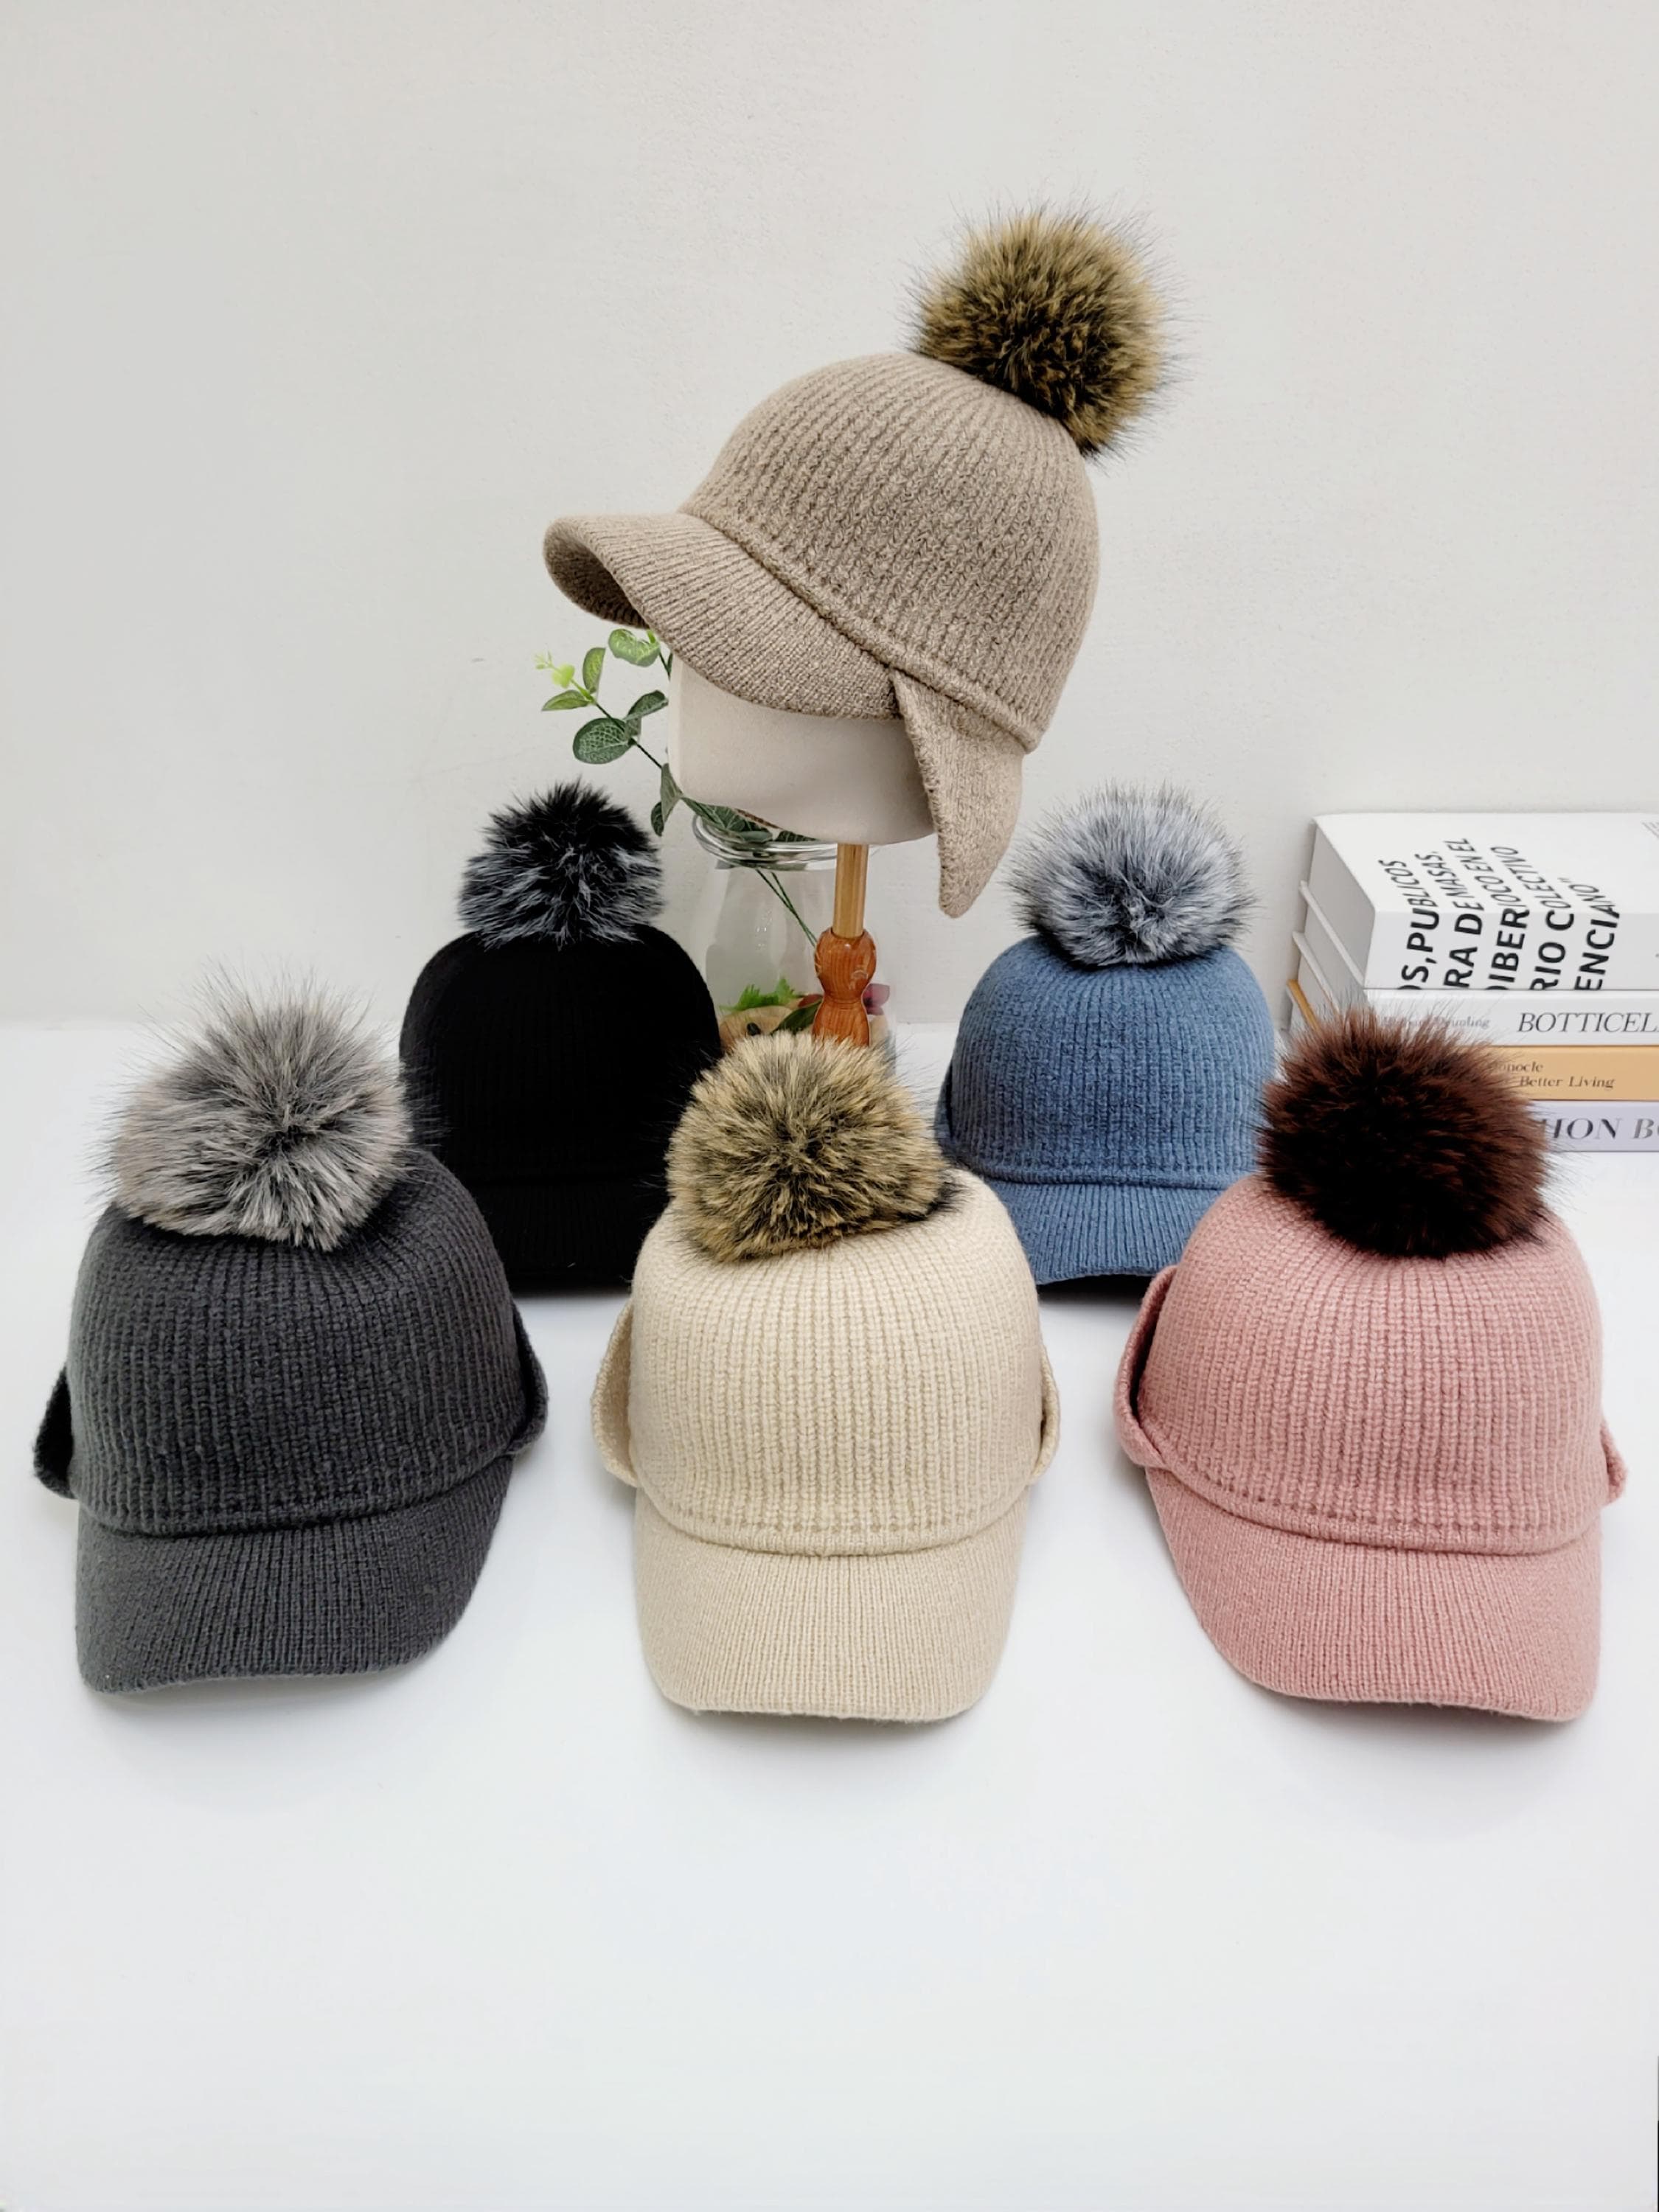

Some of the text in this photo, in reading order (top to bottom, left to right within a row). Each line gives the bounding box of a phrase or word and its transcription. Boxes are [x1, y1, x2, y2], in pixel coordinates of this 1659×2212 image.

[1443, 838, 1530, 990] IBERIOCO EN EL
[1452, 901, 1484, 935] DE
[1490, 846, 1575, 990] RIO COLECTIVO
[1520, 1076, 1615, 1088] Better Living
